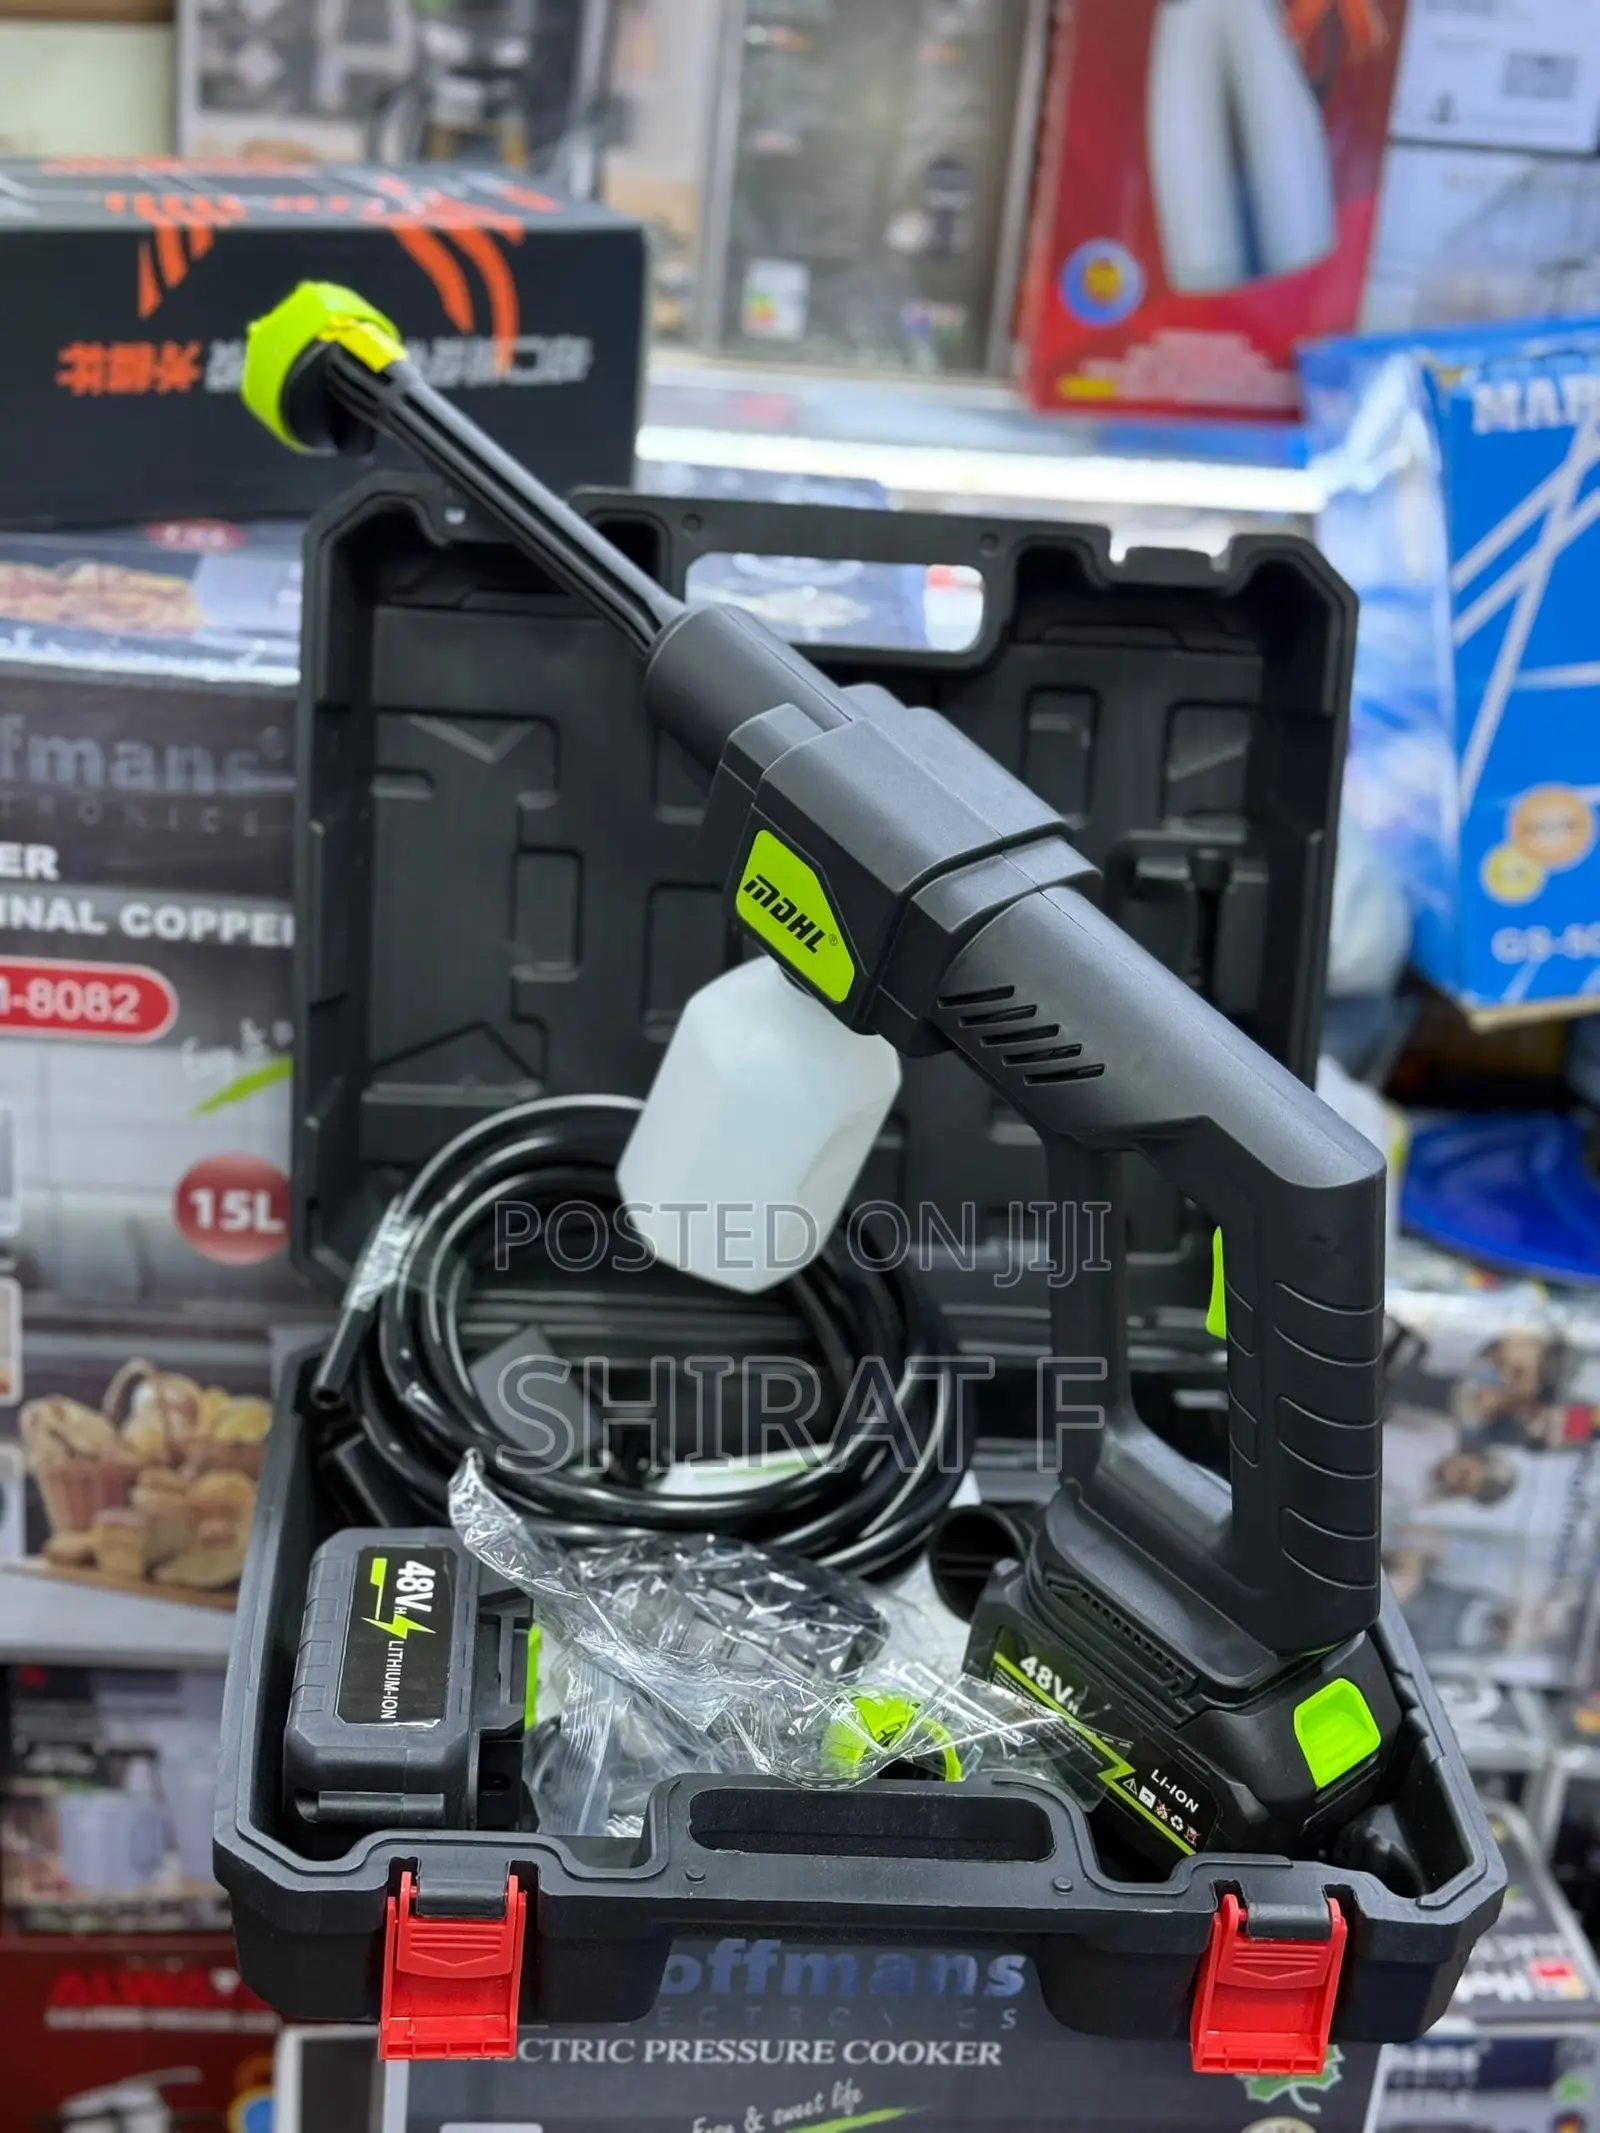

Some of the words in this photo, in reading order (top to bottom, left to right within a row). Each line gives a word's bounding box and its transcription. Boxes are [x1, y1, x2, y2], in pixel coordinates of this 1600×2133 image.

[0, 841, 60, 881] ER
[0, 976, 142, 1025] -8082
[188, 1188, 286, 1234] 15L
[380, 1640, 405, 1719] LITHIUM-ION
[642, 2039, 836, 2065] PRESSURE
[842, 2040, 1003, 2067] COOKER
